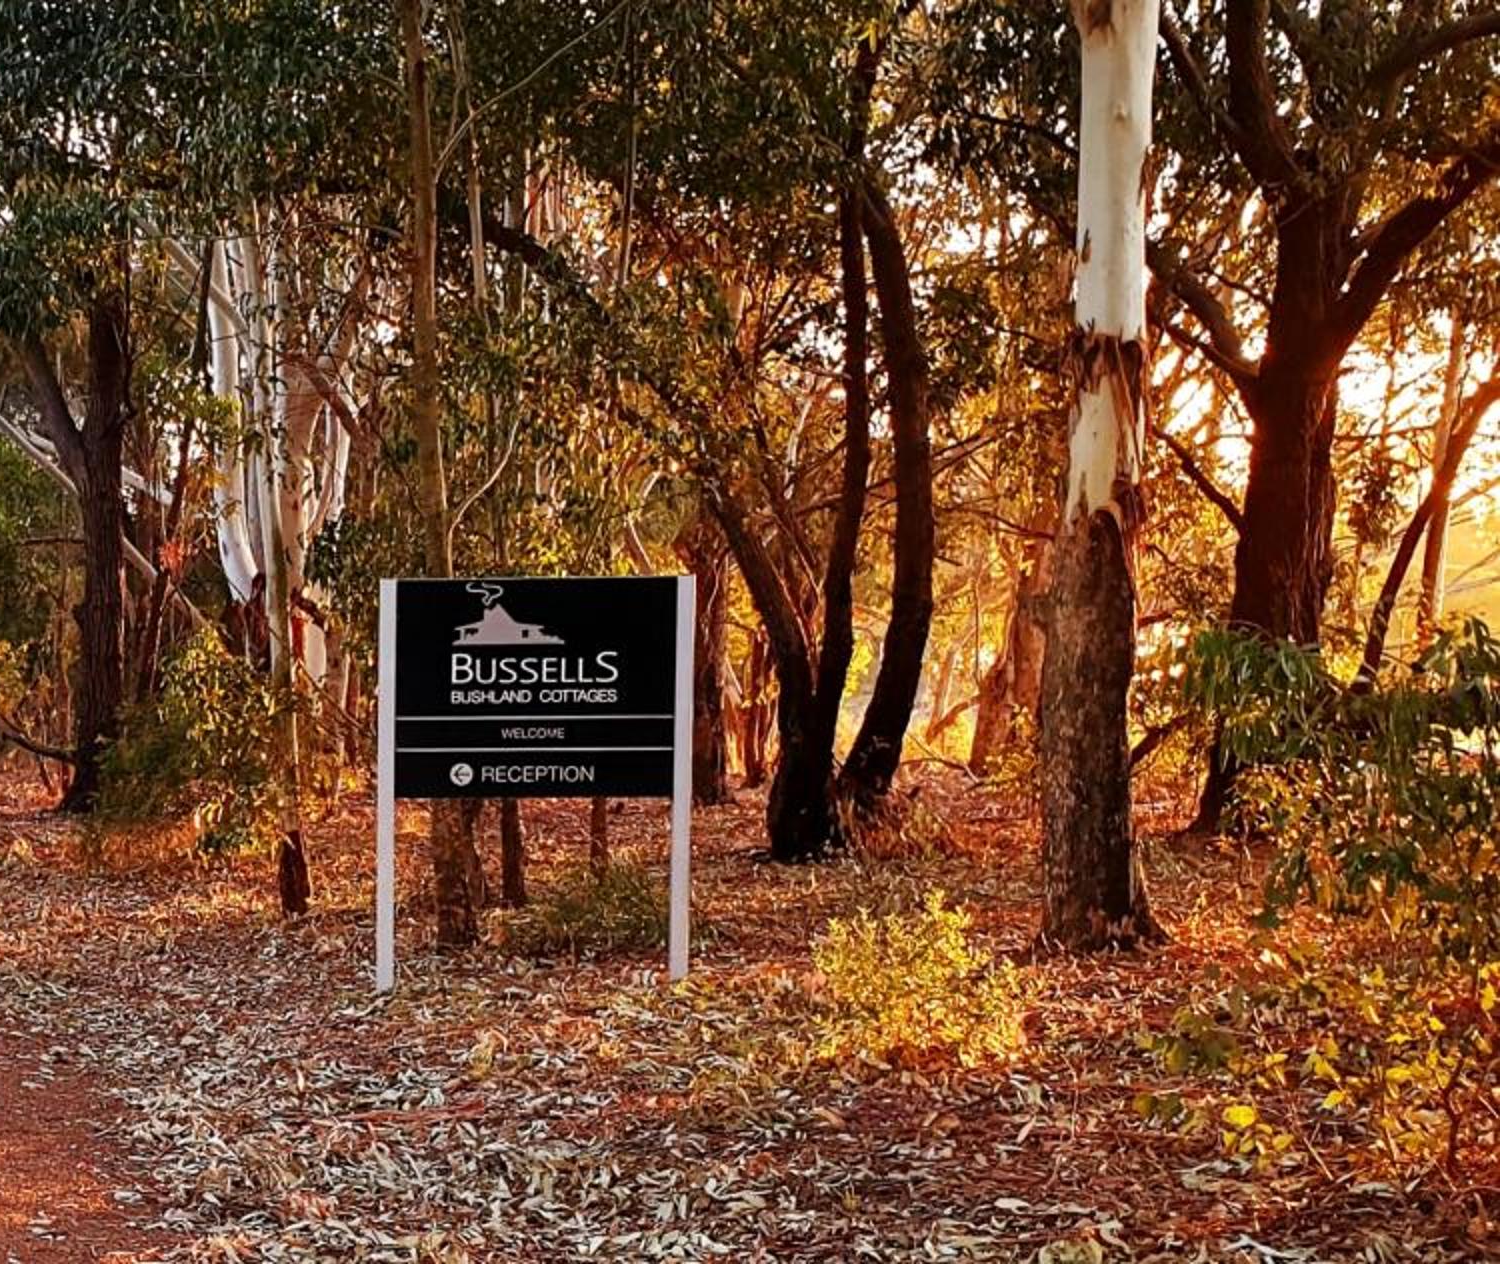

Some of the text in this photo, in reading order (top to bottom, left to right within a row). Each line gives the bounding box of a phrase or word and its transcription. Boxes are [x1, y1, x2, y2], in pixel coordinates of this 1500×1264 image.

[451, 651, 618, 684] BUSSELLS
[451, 689, 617, 704] BUSHLAND COTTAGES
[501, 727, 564, 739] WELCOME
[481, 765, 595, 782] RECEPTION
